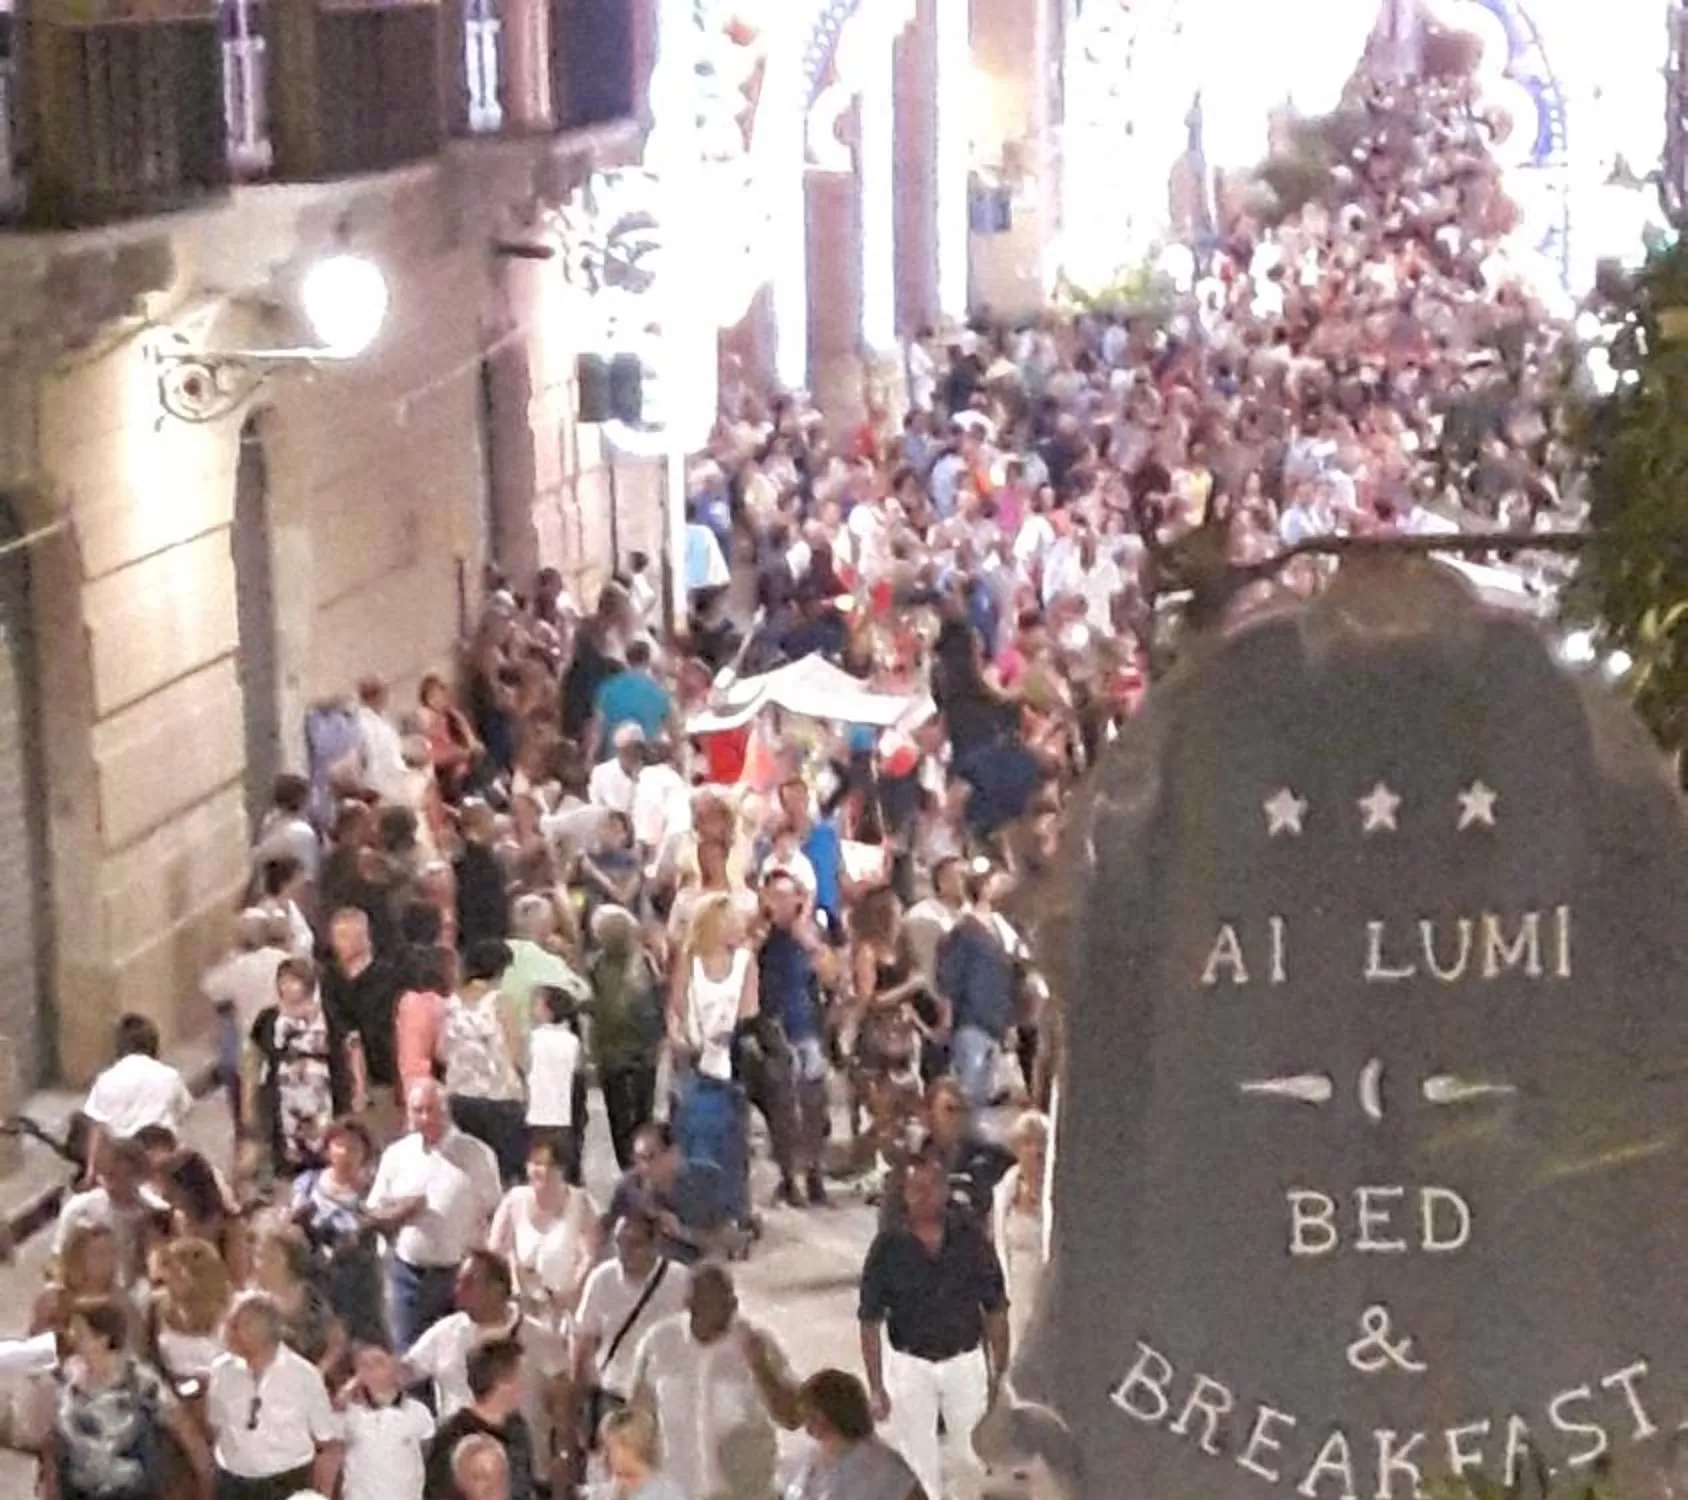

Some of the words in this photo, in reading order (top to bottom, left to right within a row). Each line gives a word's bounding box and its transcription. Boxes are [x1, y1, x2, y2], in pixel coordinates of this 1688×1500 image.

[1201, 915, 1287, 983] AI
[1365, 905, 1571, 982] LUMI
[1287, 1186, 1472, 1255] BED
[1346, 1305, 1427, 1371] &
